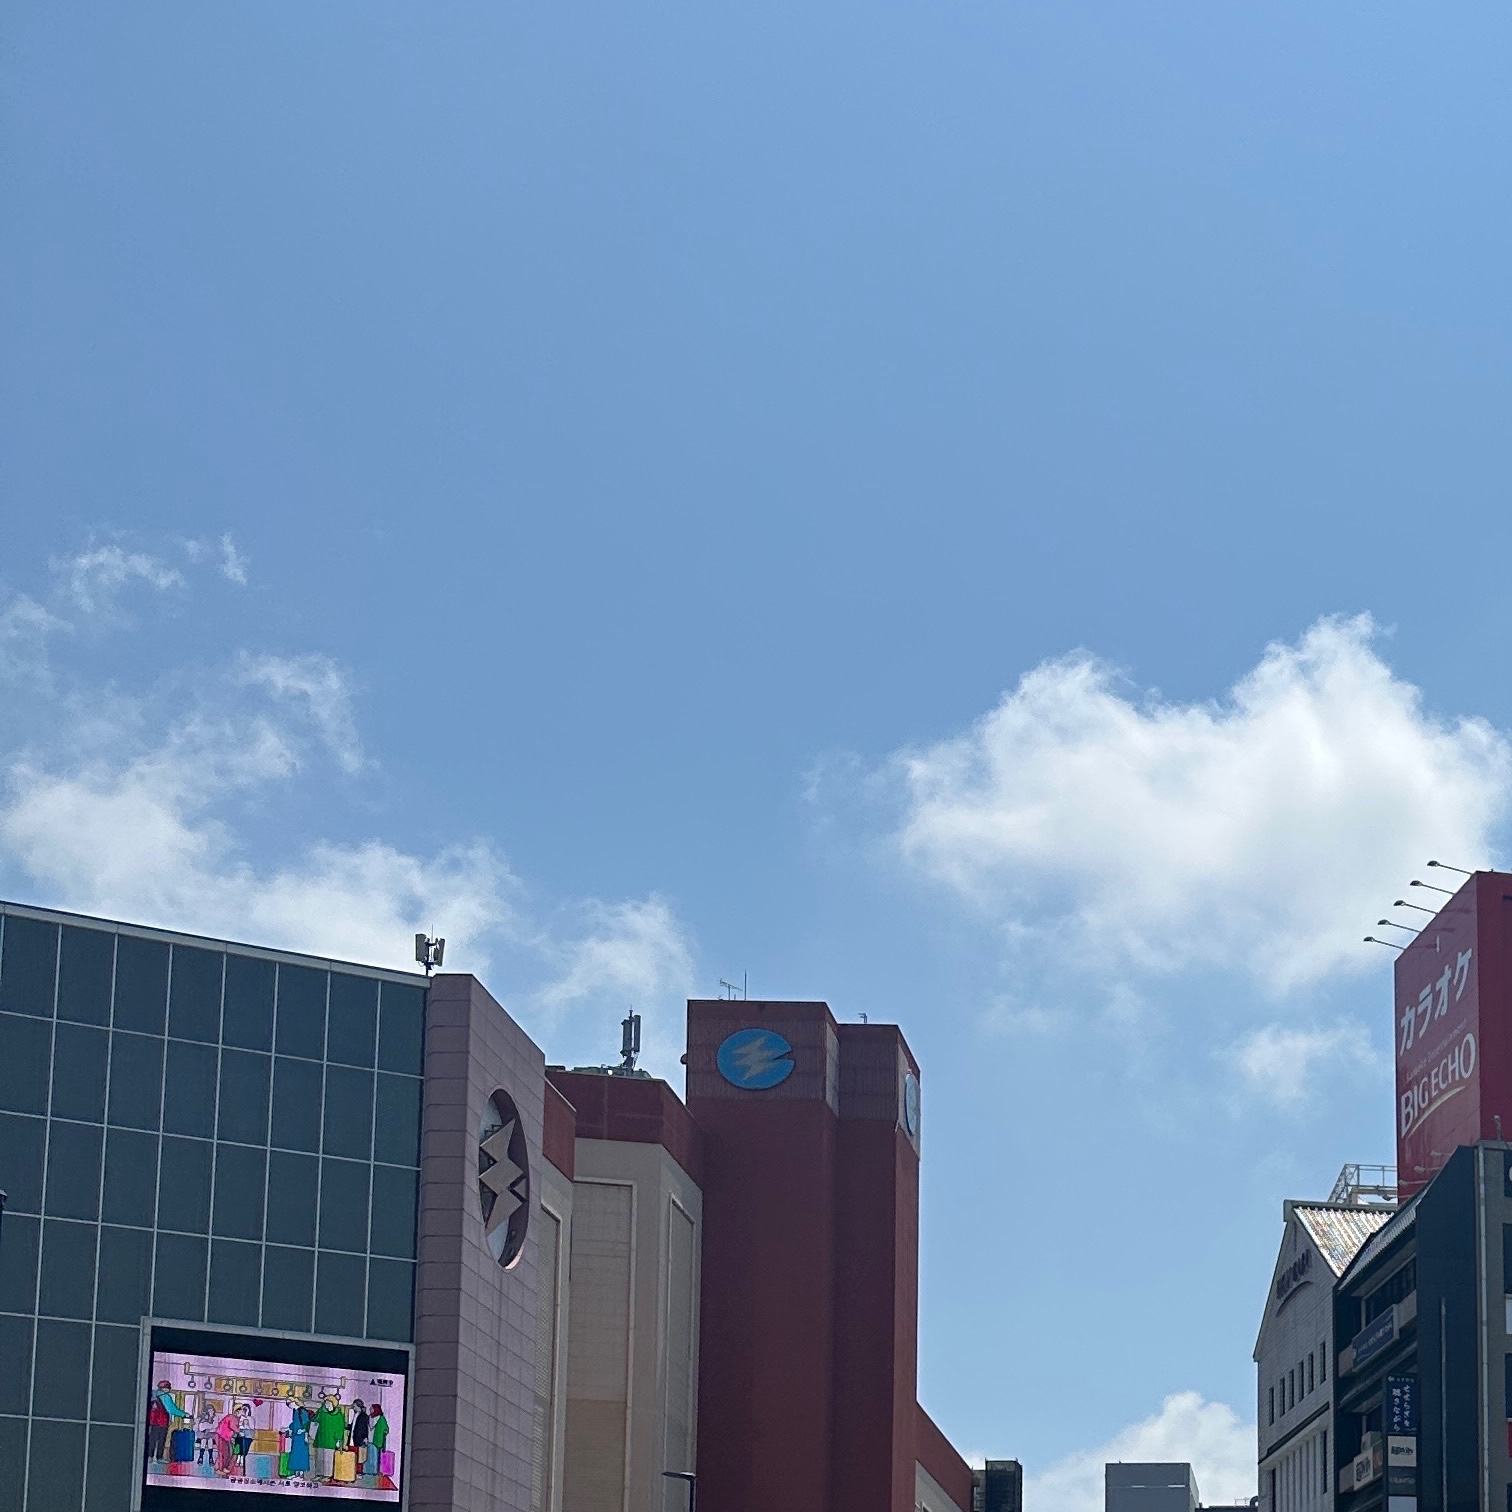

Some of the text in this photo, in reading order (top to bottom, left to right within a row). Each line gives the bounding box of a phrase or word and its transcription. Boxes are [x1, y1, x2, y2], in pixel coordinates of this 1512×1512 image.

[1400, 947, 1473, 1057] カラオケ
[1401, 1033, 1477, 1139] BIG ECHO
